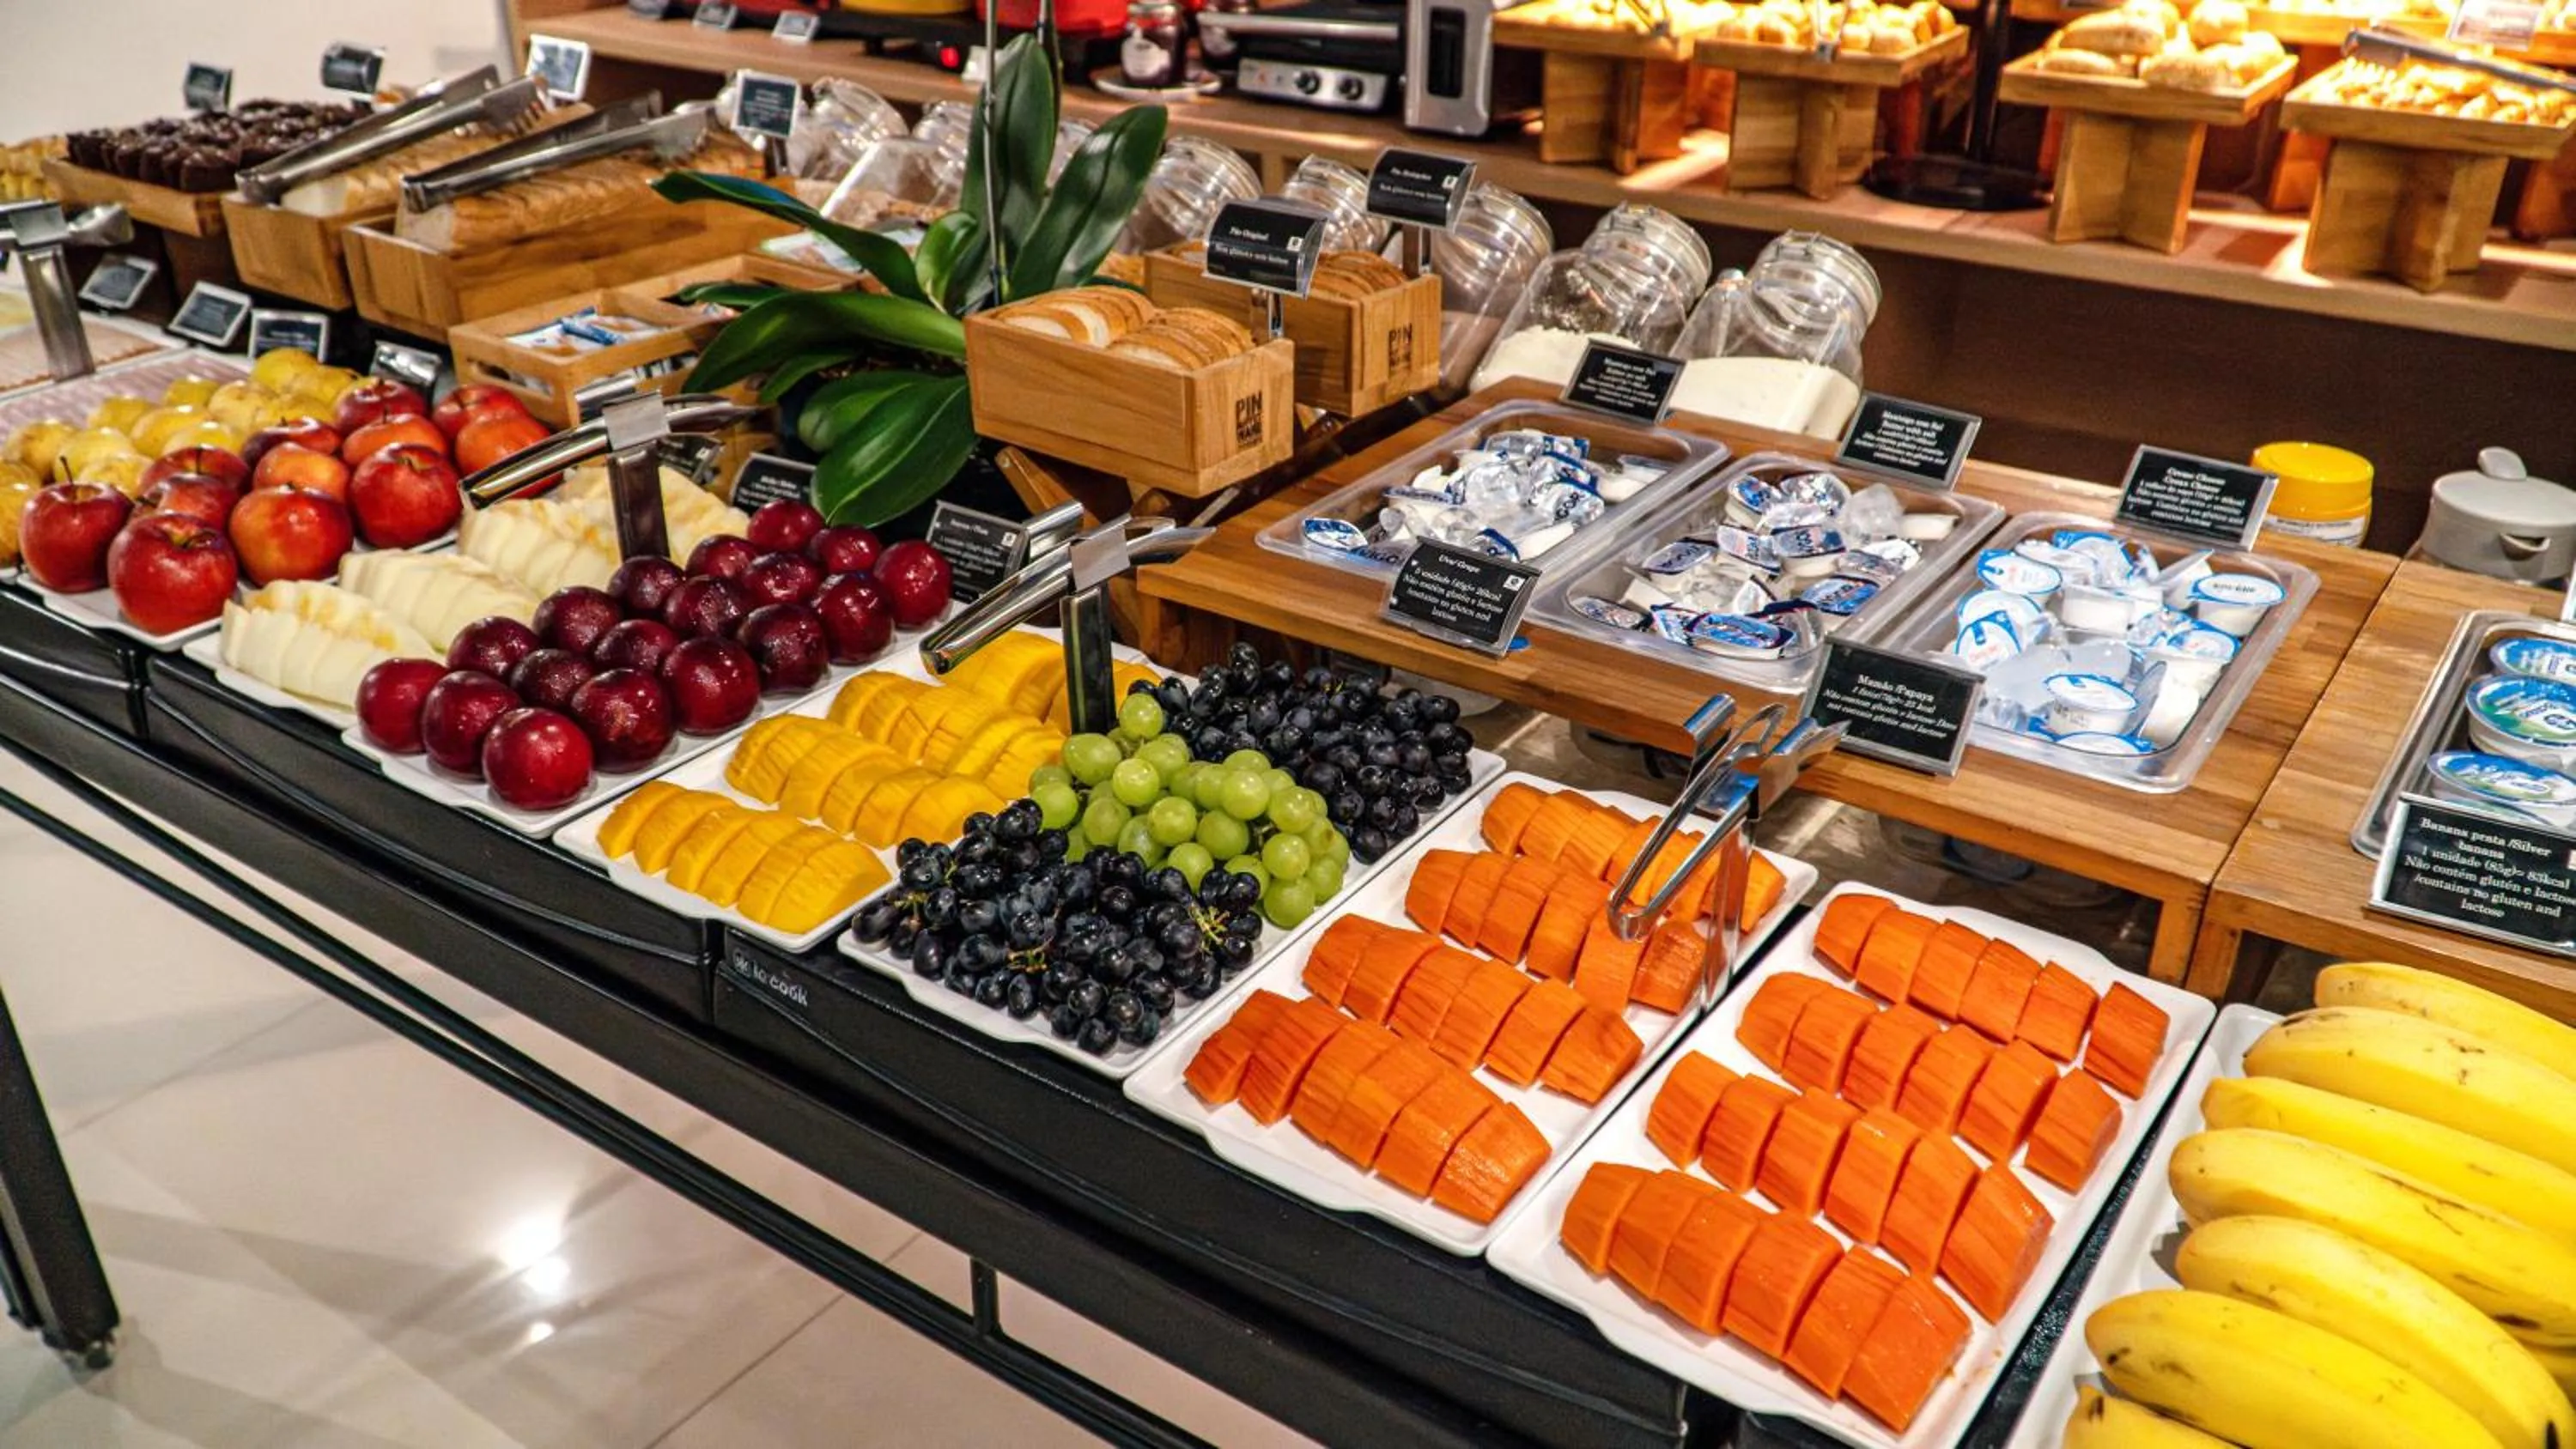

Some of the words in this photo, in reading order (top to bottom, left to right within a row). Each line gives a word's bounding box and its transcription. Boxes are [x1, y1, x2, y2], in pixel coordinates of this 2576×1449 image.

[1236, 391, 1262, 421] PIN
[2421, 817, 2469, 837] Banana
[769, 976, 808, 1008] cook
